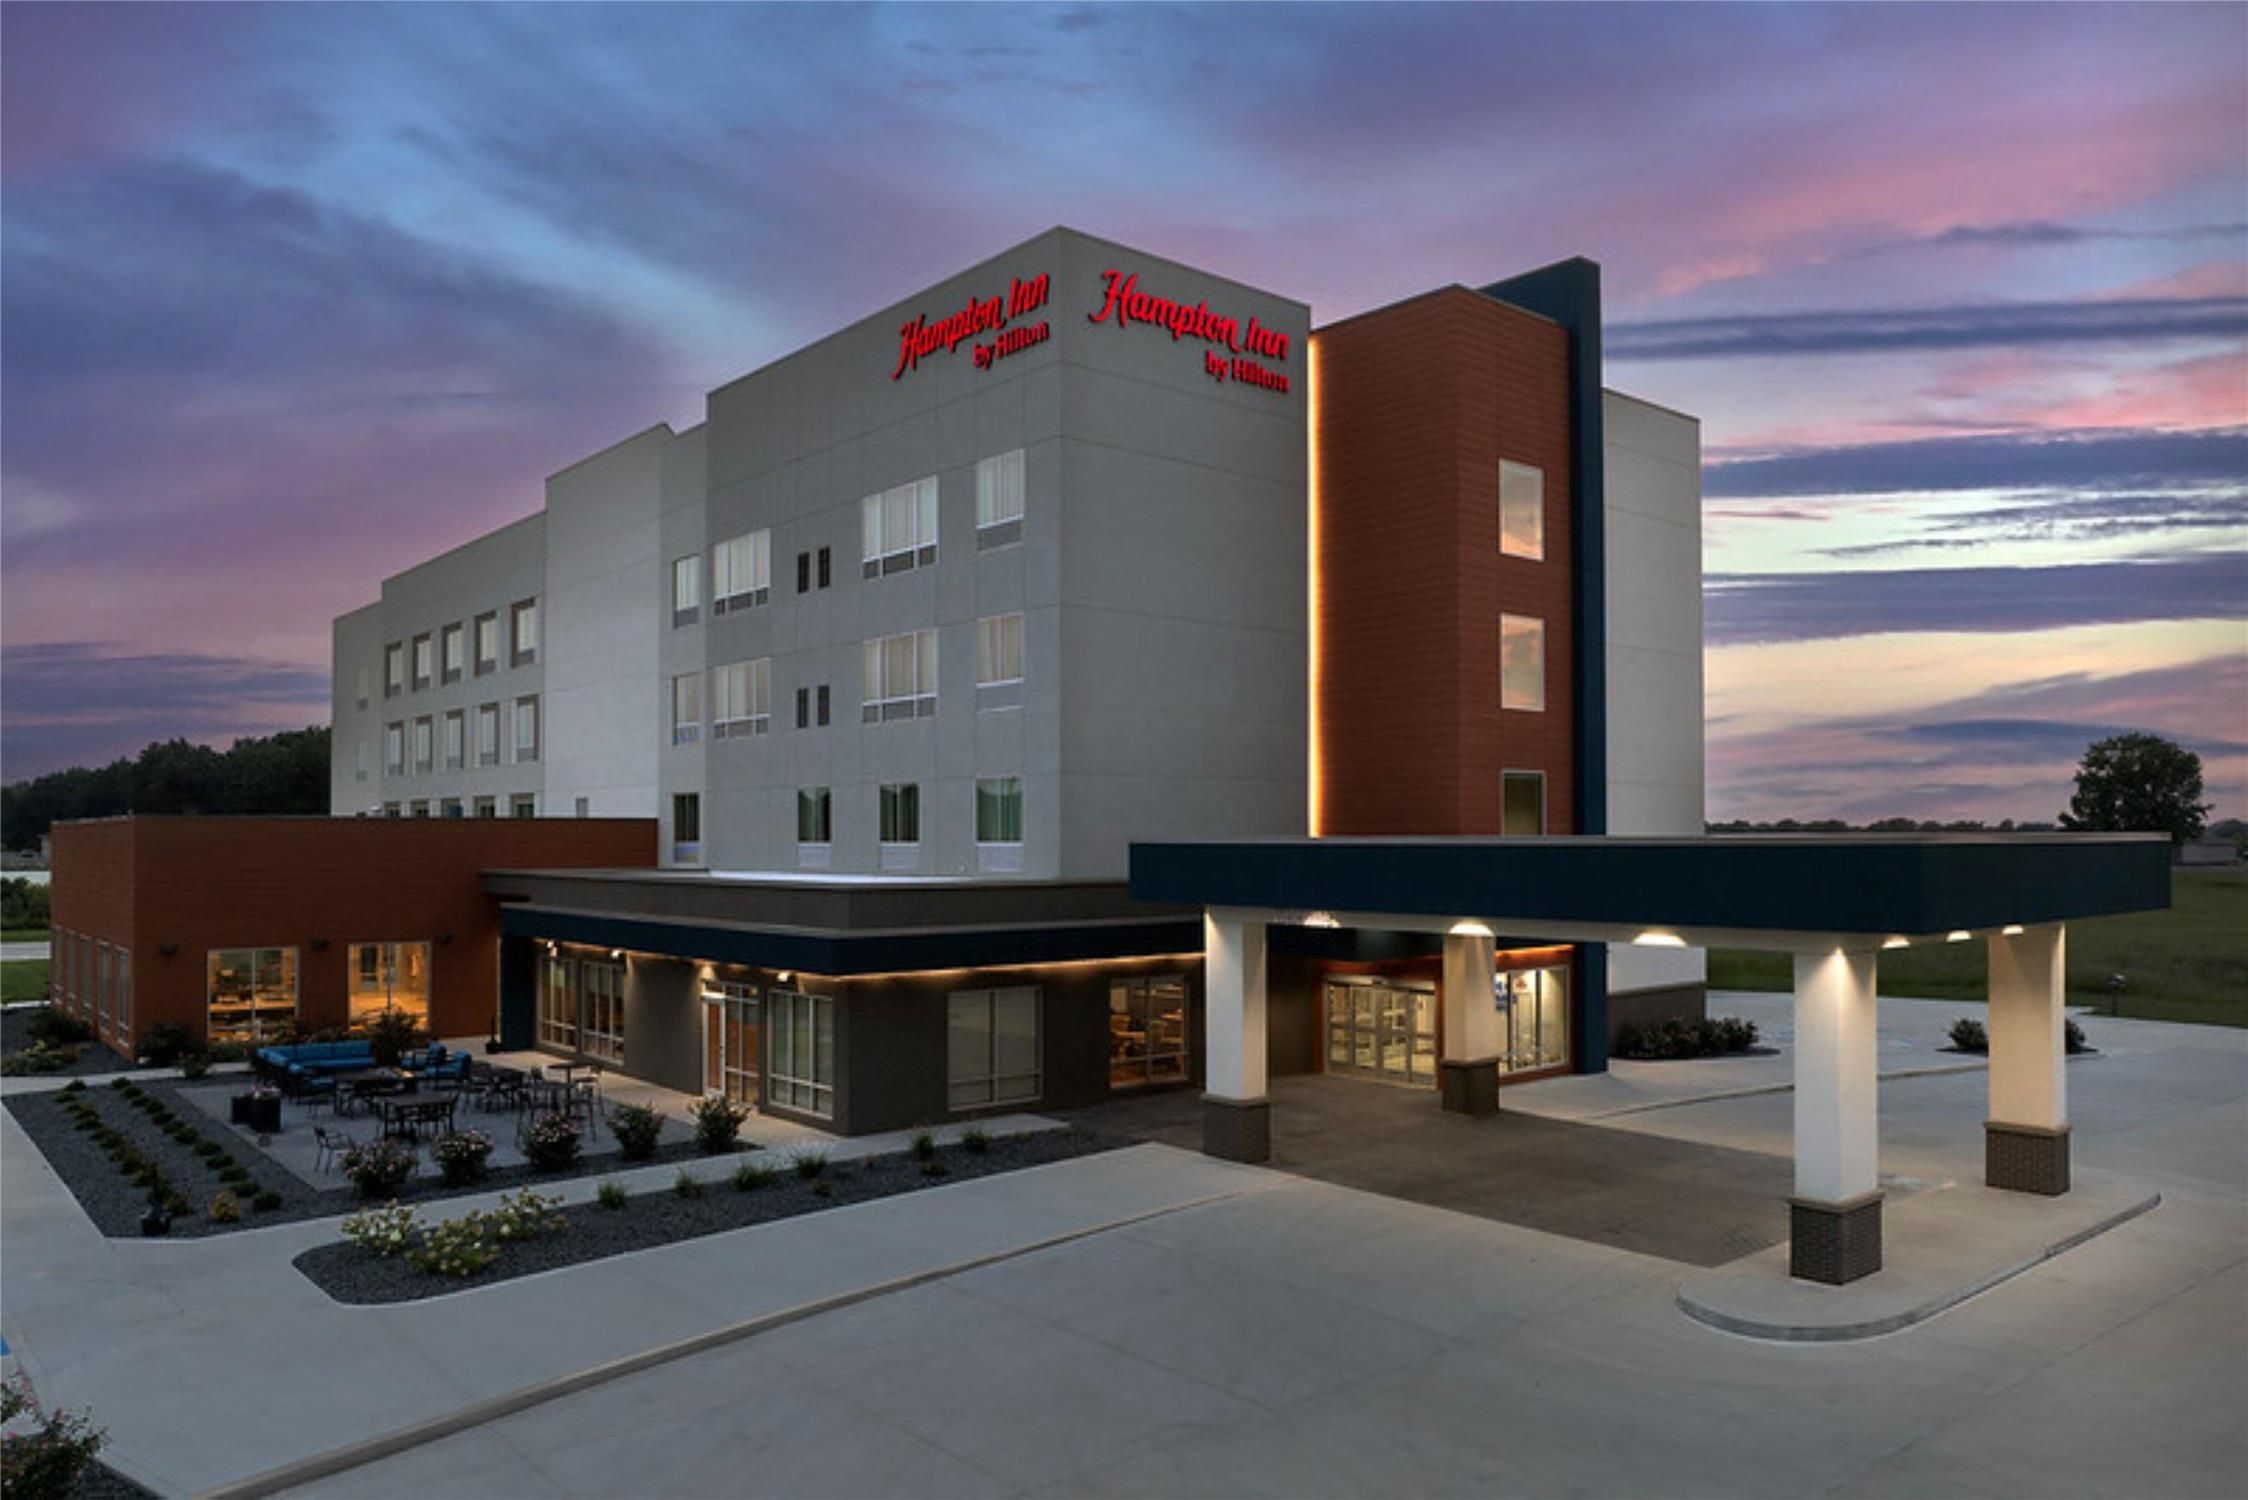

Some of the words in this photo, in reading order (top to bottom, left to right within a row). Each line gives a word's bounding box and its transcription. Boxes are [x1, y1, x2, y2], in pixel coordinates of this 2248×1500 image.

[889, 294, 1003, 380] Hampton
[1007, 271, 1049, 318] Inn
[973, 343, 994, 370] by
[995, 321, 1049, 358] Hilton
[1089, 268, 1242, 352] Hampton
[1244, 316, 1291, 360] Inn
[1206, 350, 1231, 382] by
[1232, 357, 1290, 394] Hilton
